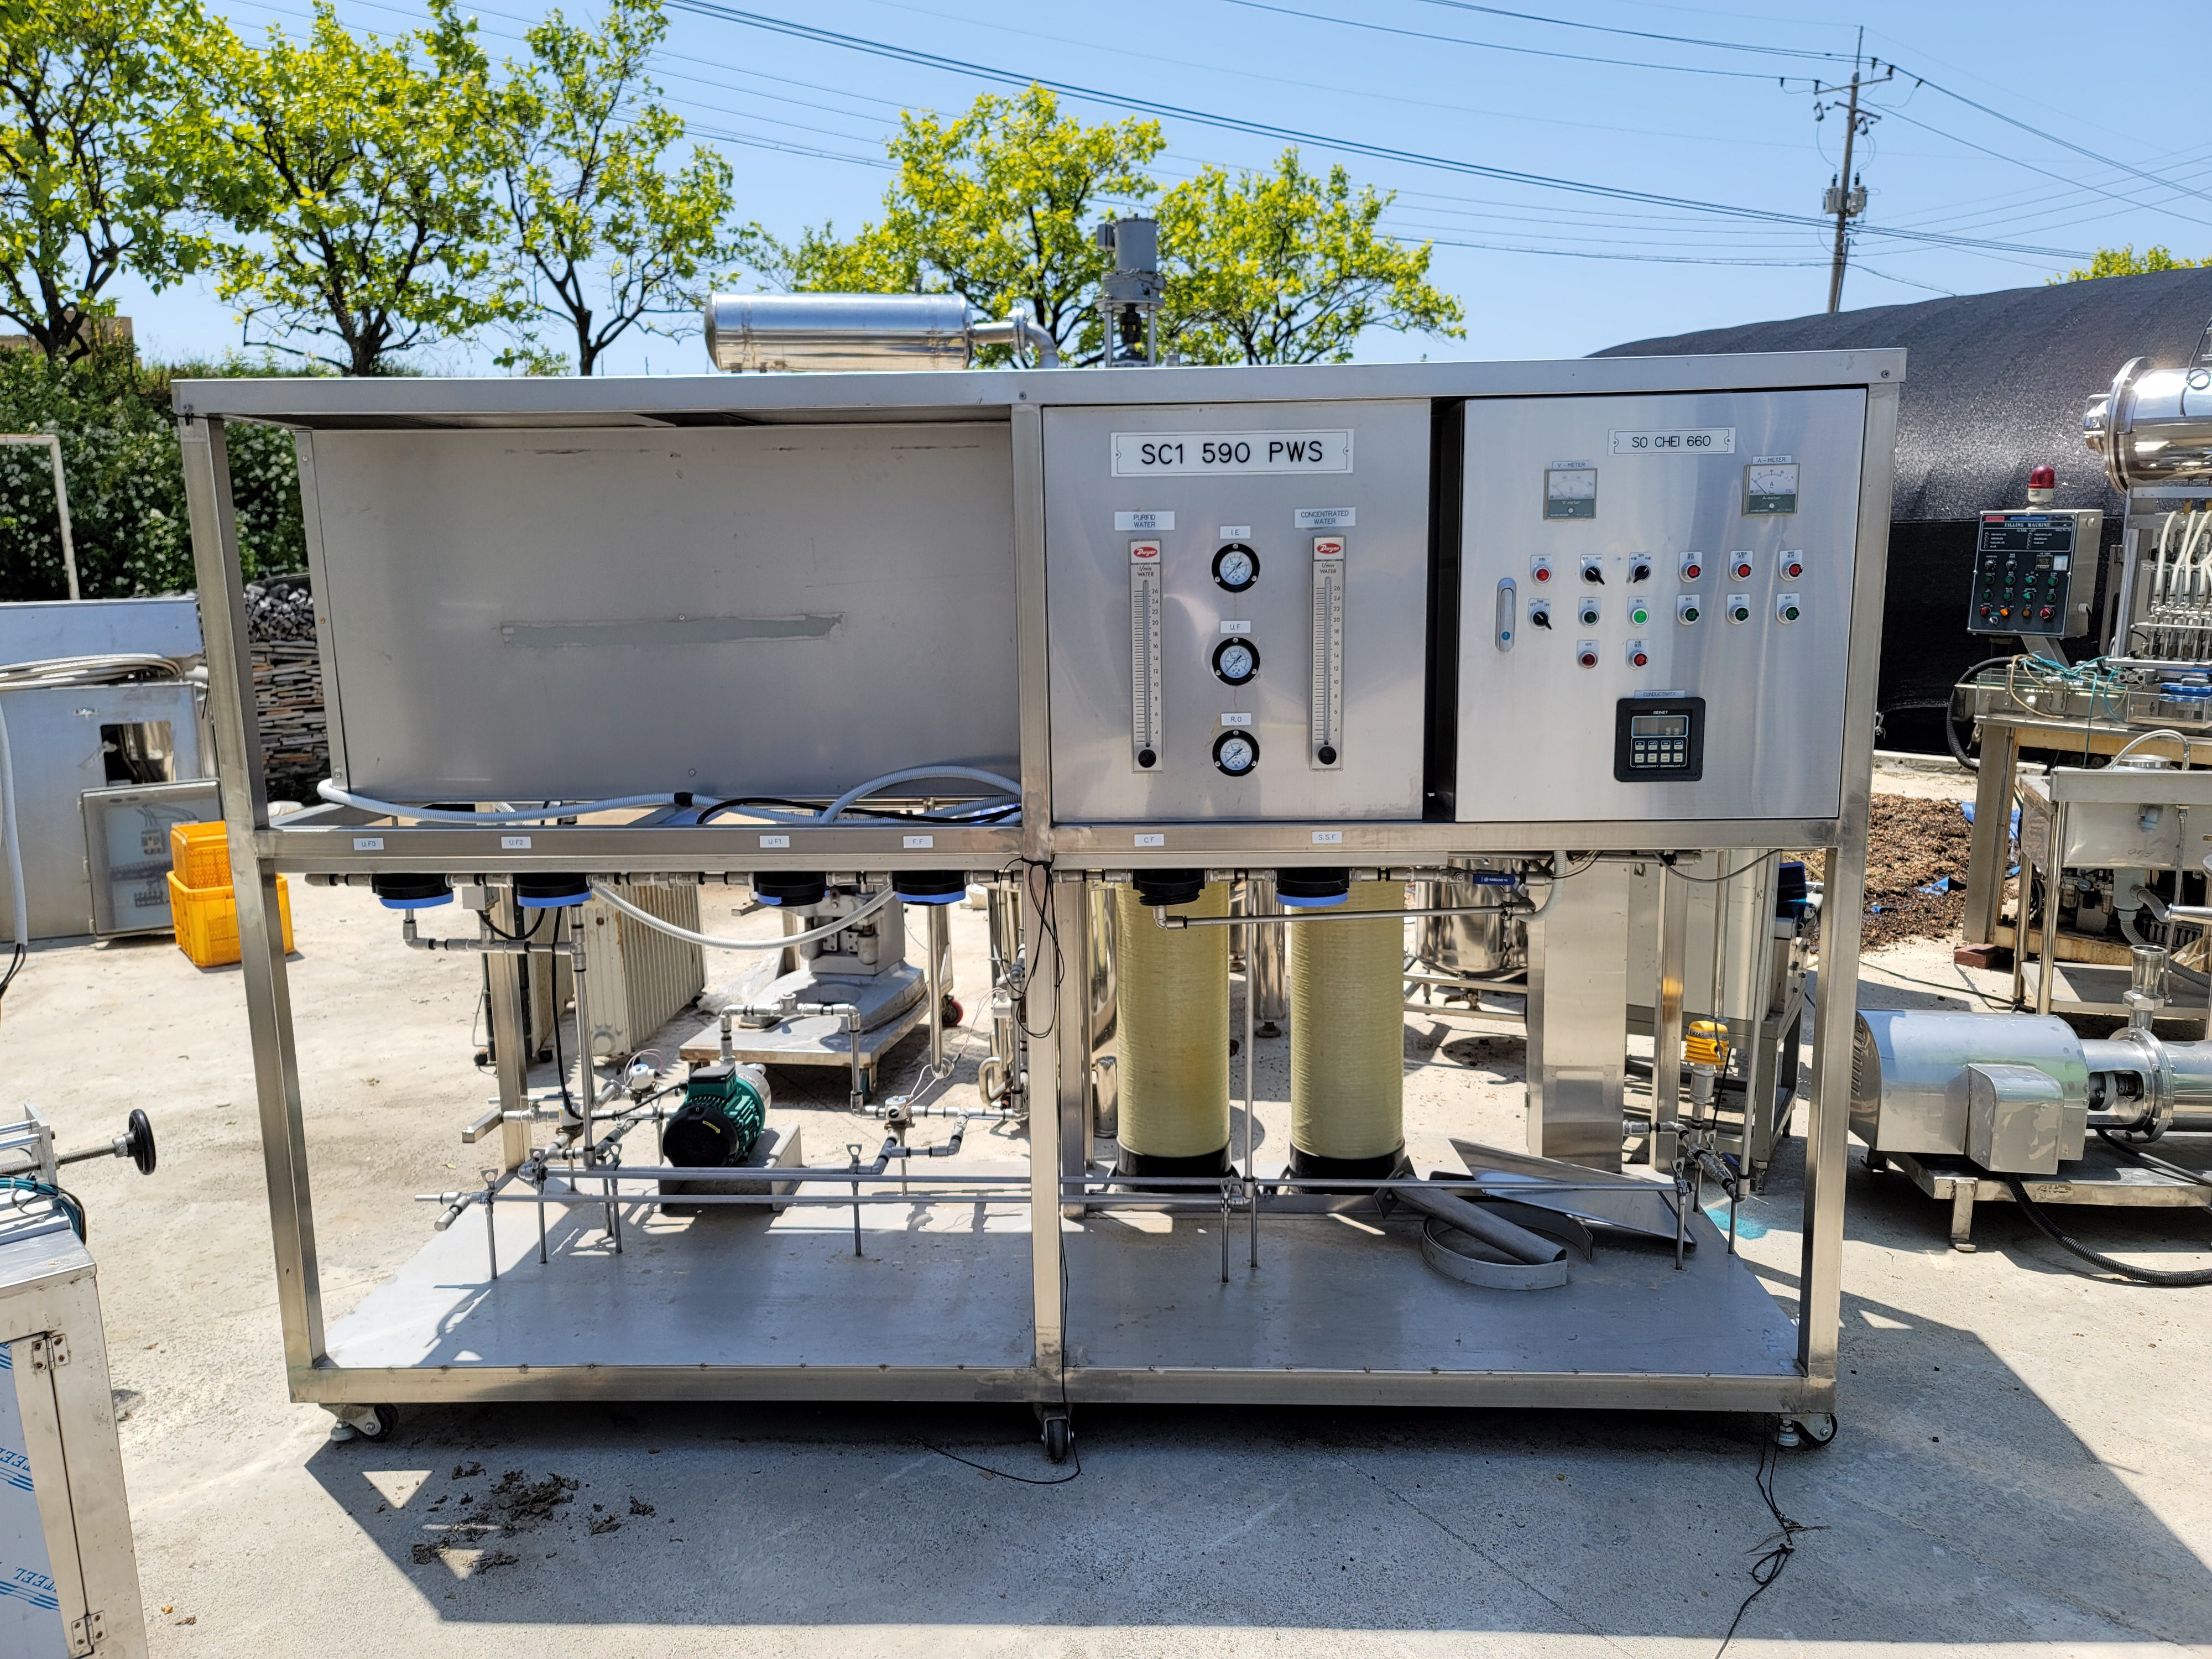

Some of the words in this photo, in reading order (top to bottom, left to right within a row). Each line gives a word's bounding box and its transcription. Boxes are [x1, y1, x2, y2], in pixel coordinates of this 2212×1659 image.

[1654, 436, 1680, 448] CHEI
[1687, 435, 1712, 447] 660
[1141, 444, 1183, 465] SC1
[1202, 442, 1250, 464] 590
[1269, 441, 1323, 463] PWS
[1300, 510, 1349, 518] CONCENTRATED
[1136, 547, 1156, 557] Dwyer
[1319, 544, 1339, 553] Dwyer
